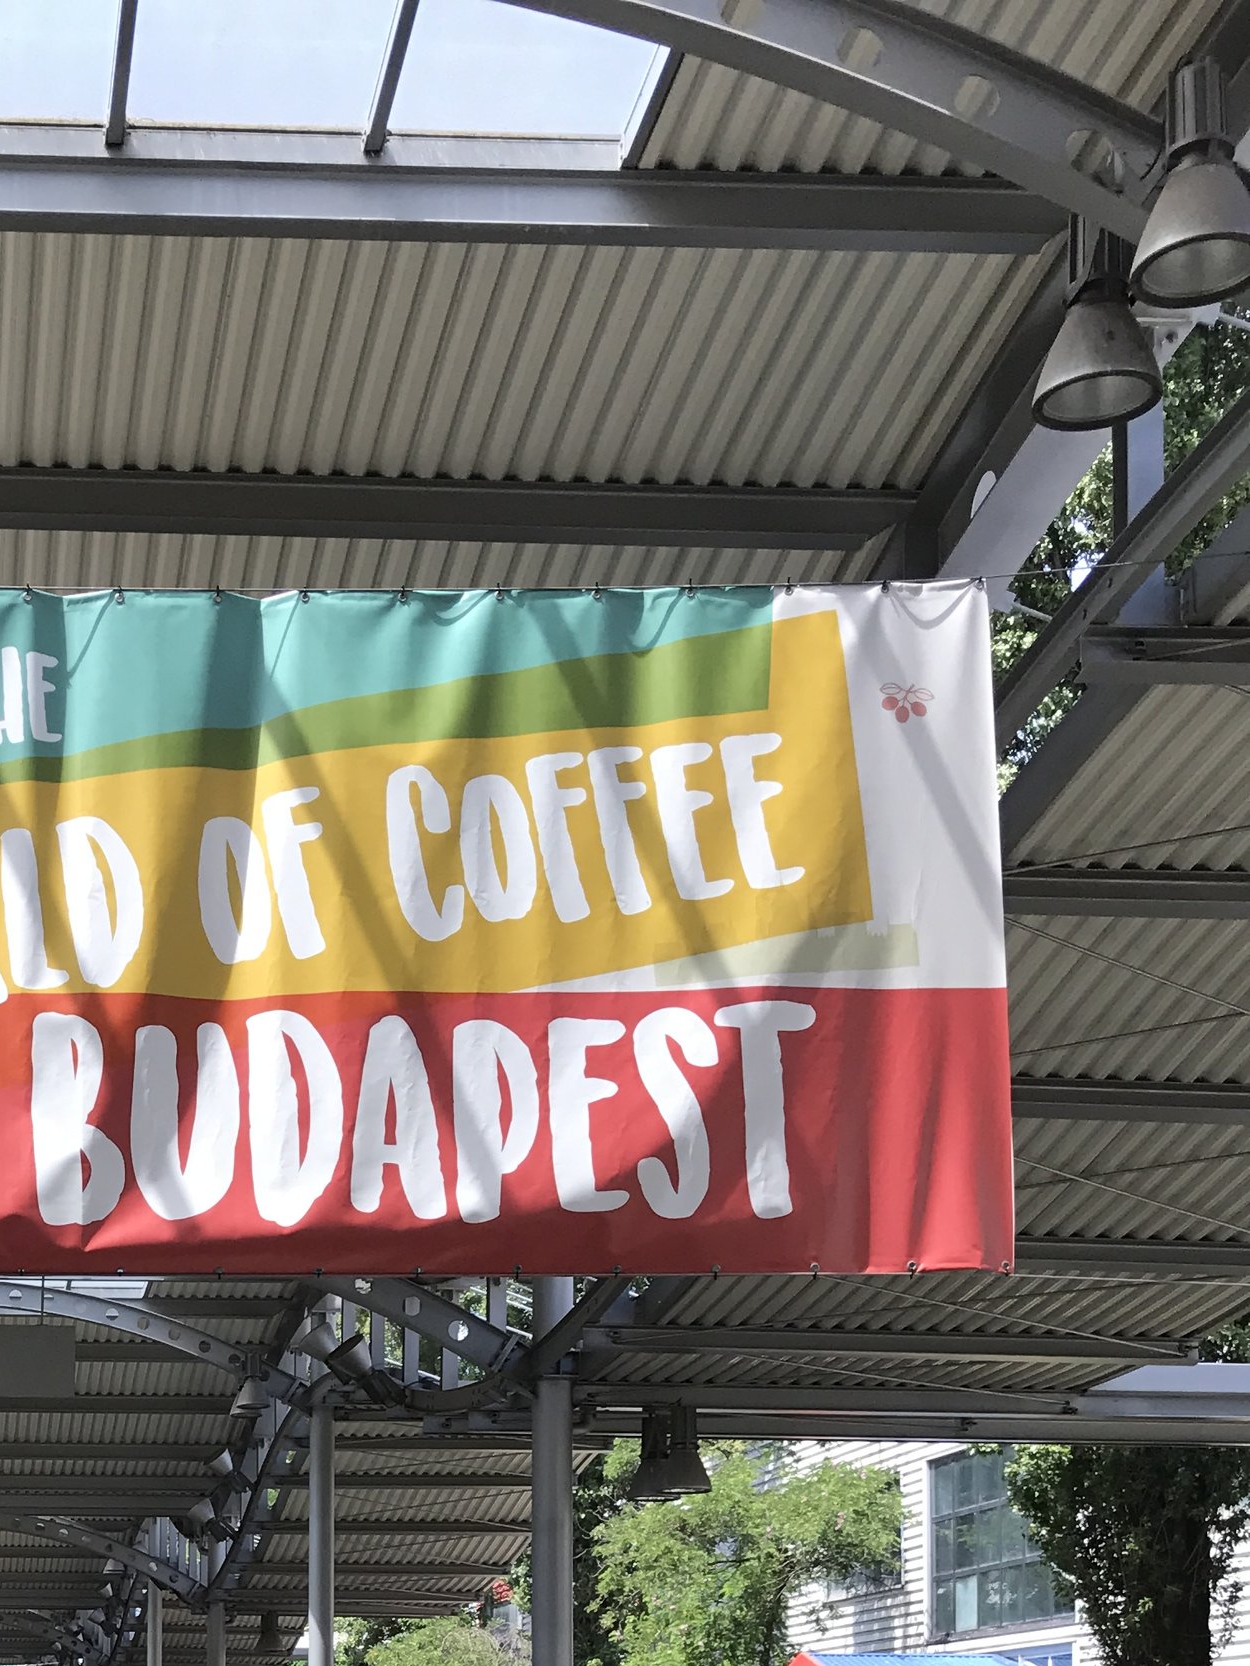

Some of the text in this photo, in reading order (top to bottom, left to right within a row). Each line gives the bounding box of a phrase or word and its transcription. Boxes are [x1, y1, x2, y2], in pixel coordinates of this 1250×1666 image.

[198, 786, 326, 964] OF
[386, 732, 805, 941] COFFEE
[30, 1000, 817, 1227] BUDAPEST
